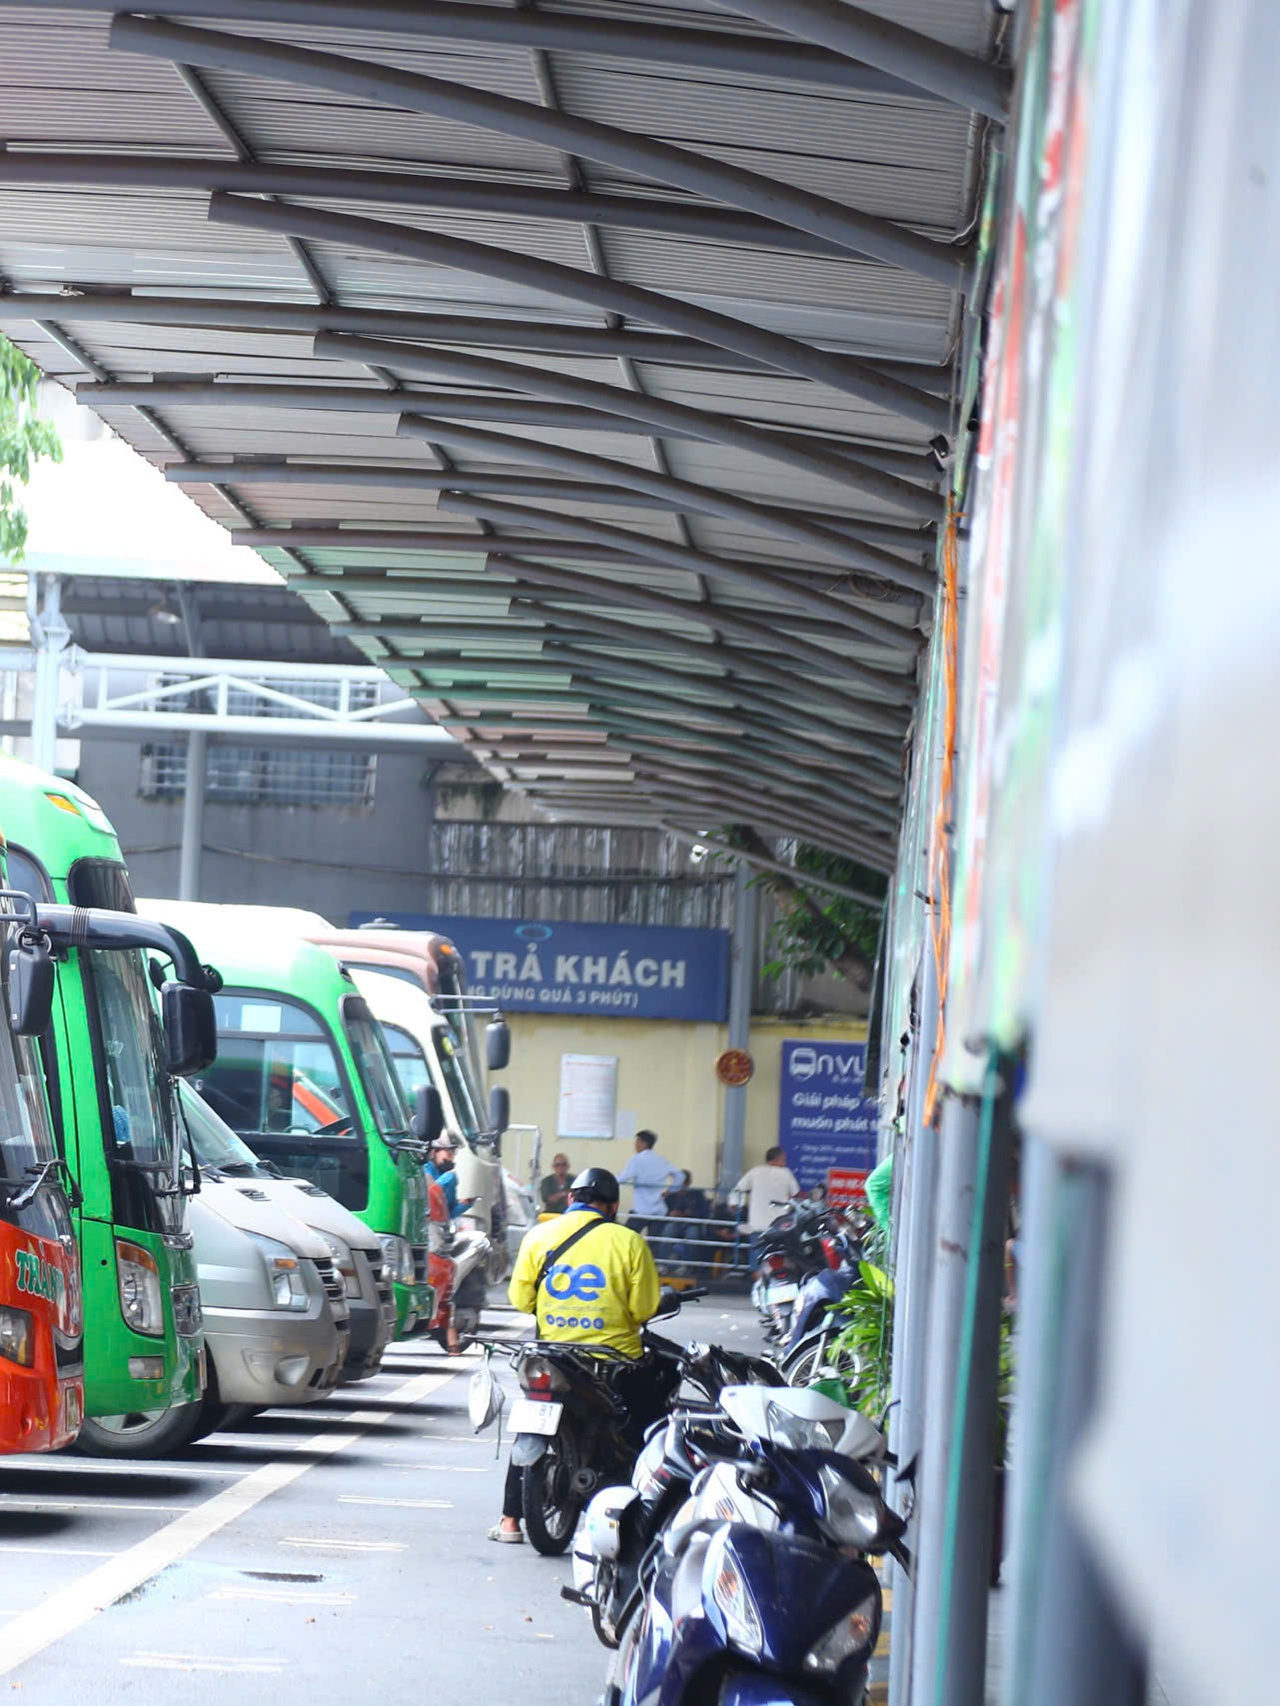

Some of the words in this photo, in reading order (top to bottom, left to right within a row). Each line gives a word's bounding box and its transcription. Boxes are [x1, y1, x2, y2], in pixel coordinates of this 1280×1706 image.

[470, 942, 543, 981] TRẢ
[555, 949, 686, 988] KHÁCH
[539, 986, 572, 1004] QUÁ
[577, 989, 587, 1004] 3
